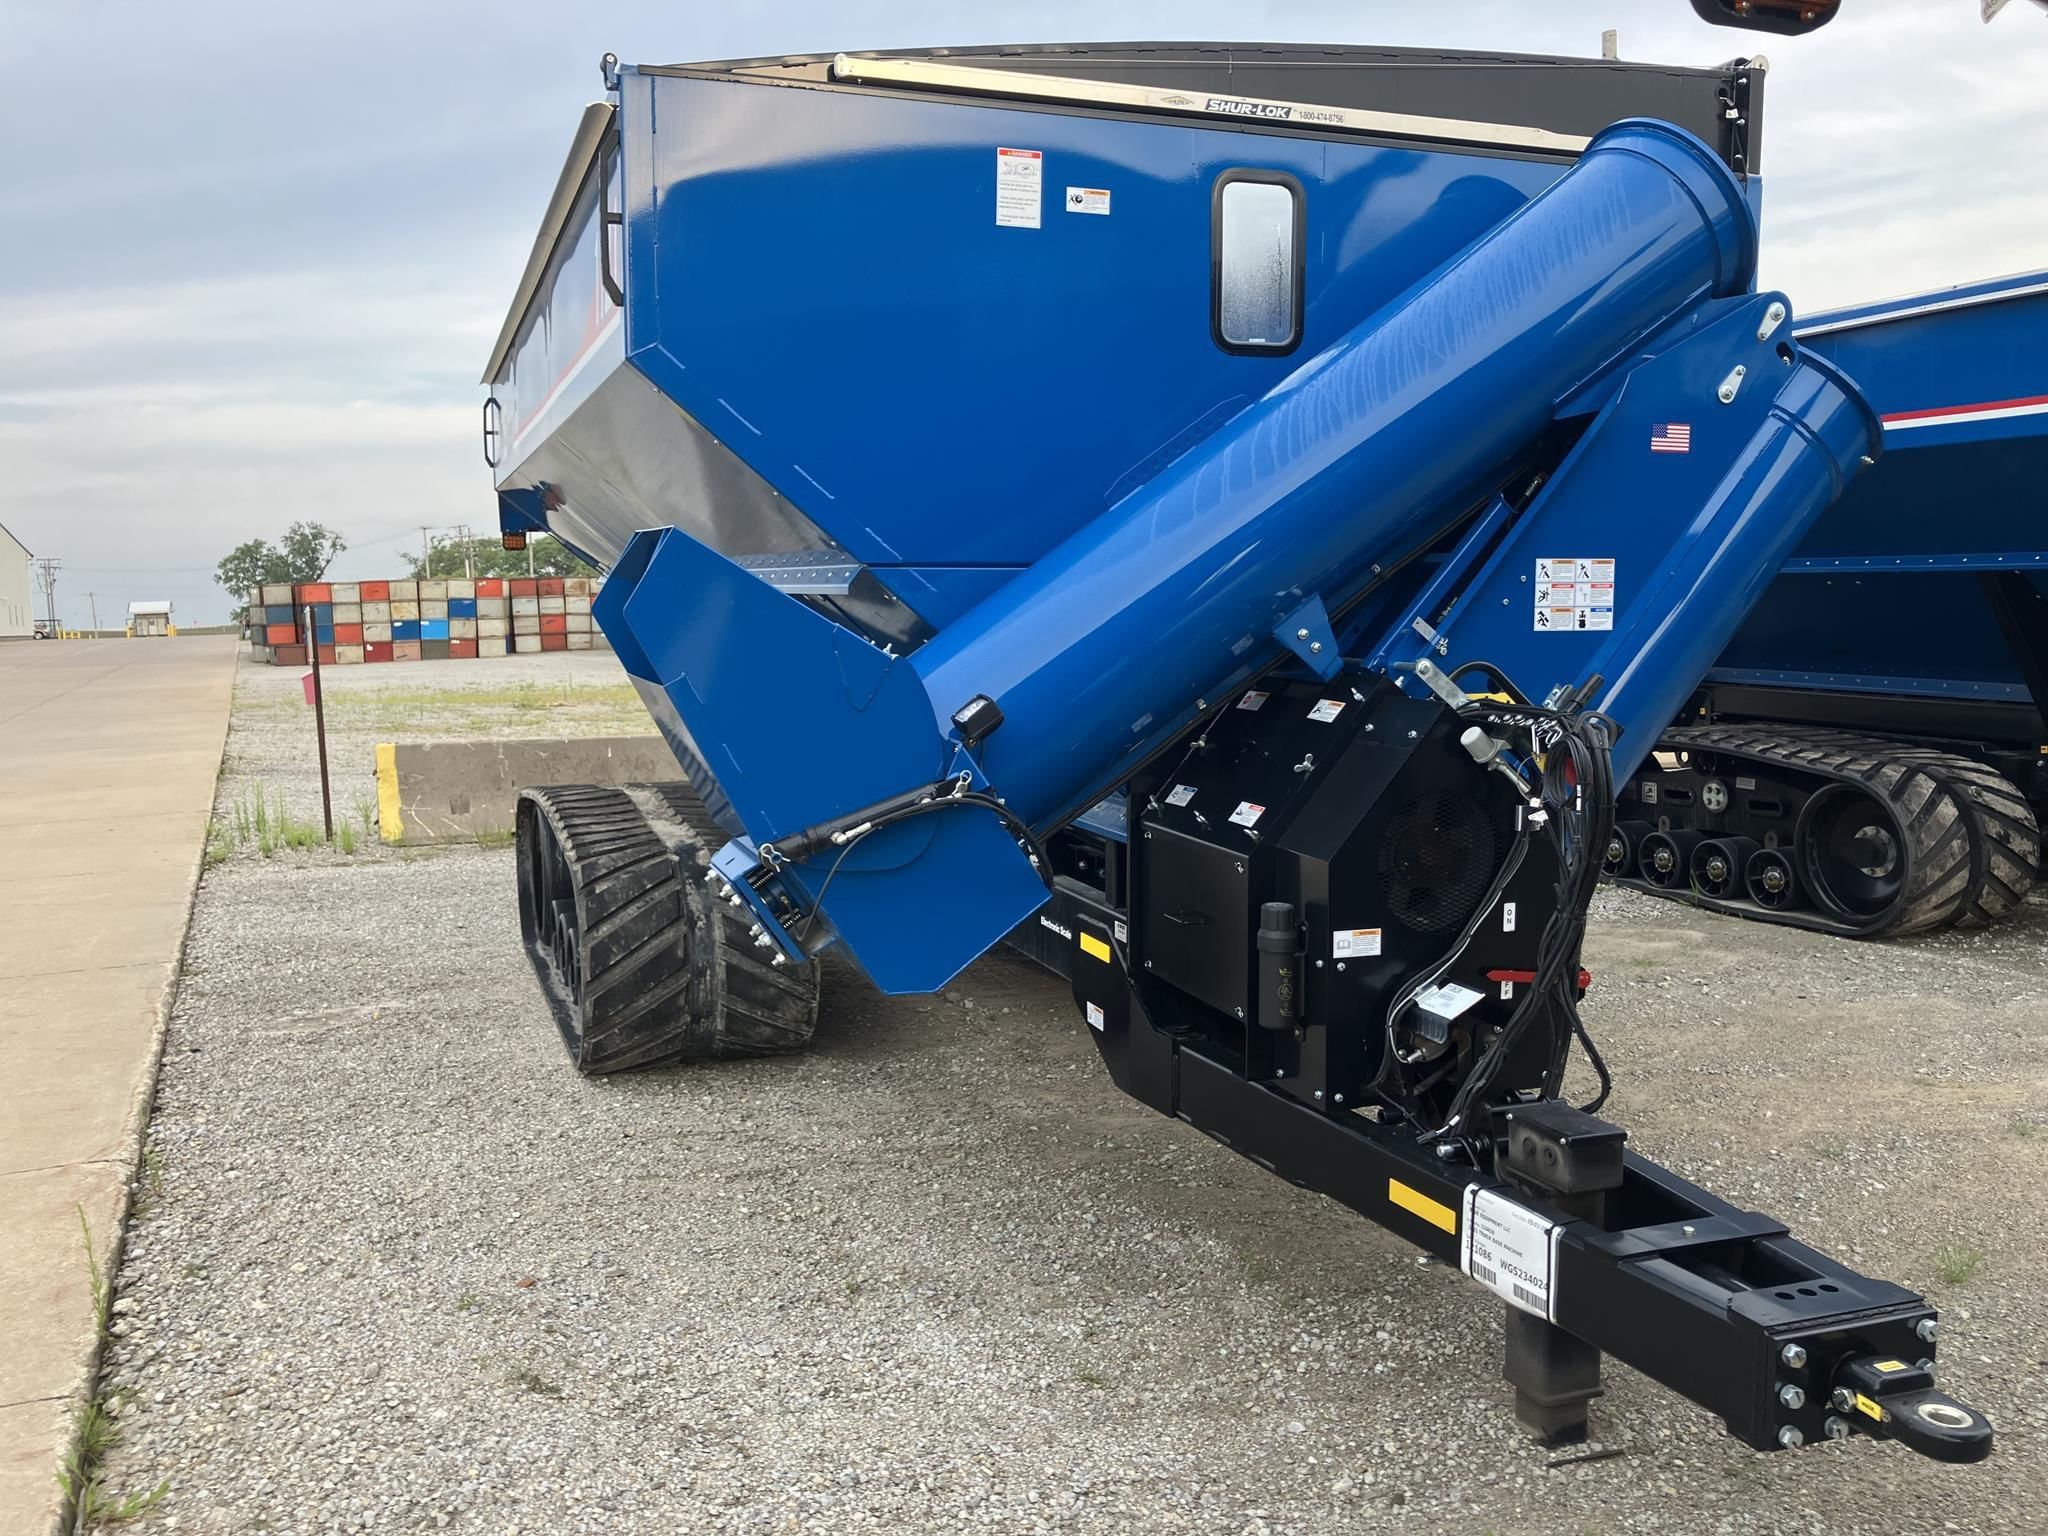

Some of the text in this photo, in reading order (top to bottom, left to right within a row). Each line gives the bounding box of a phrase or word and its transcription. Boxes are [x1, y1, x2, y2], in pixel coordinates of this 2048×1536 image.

[1208, 100, 1344, 123] SHUR-LOK 1-800-474-8756
[1507, 909, 1512, 924] ON
